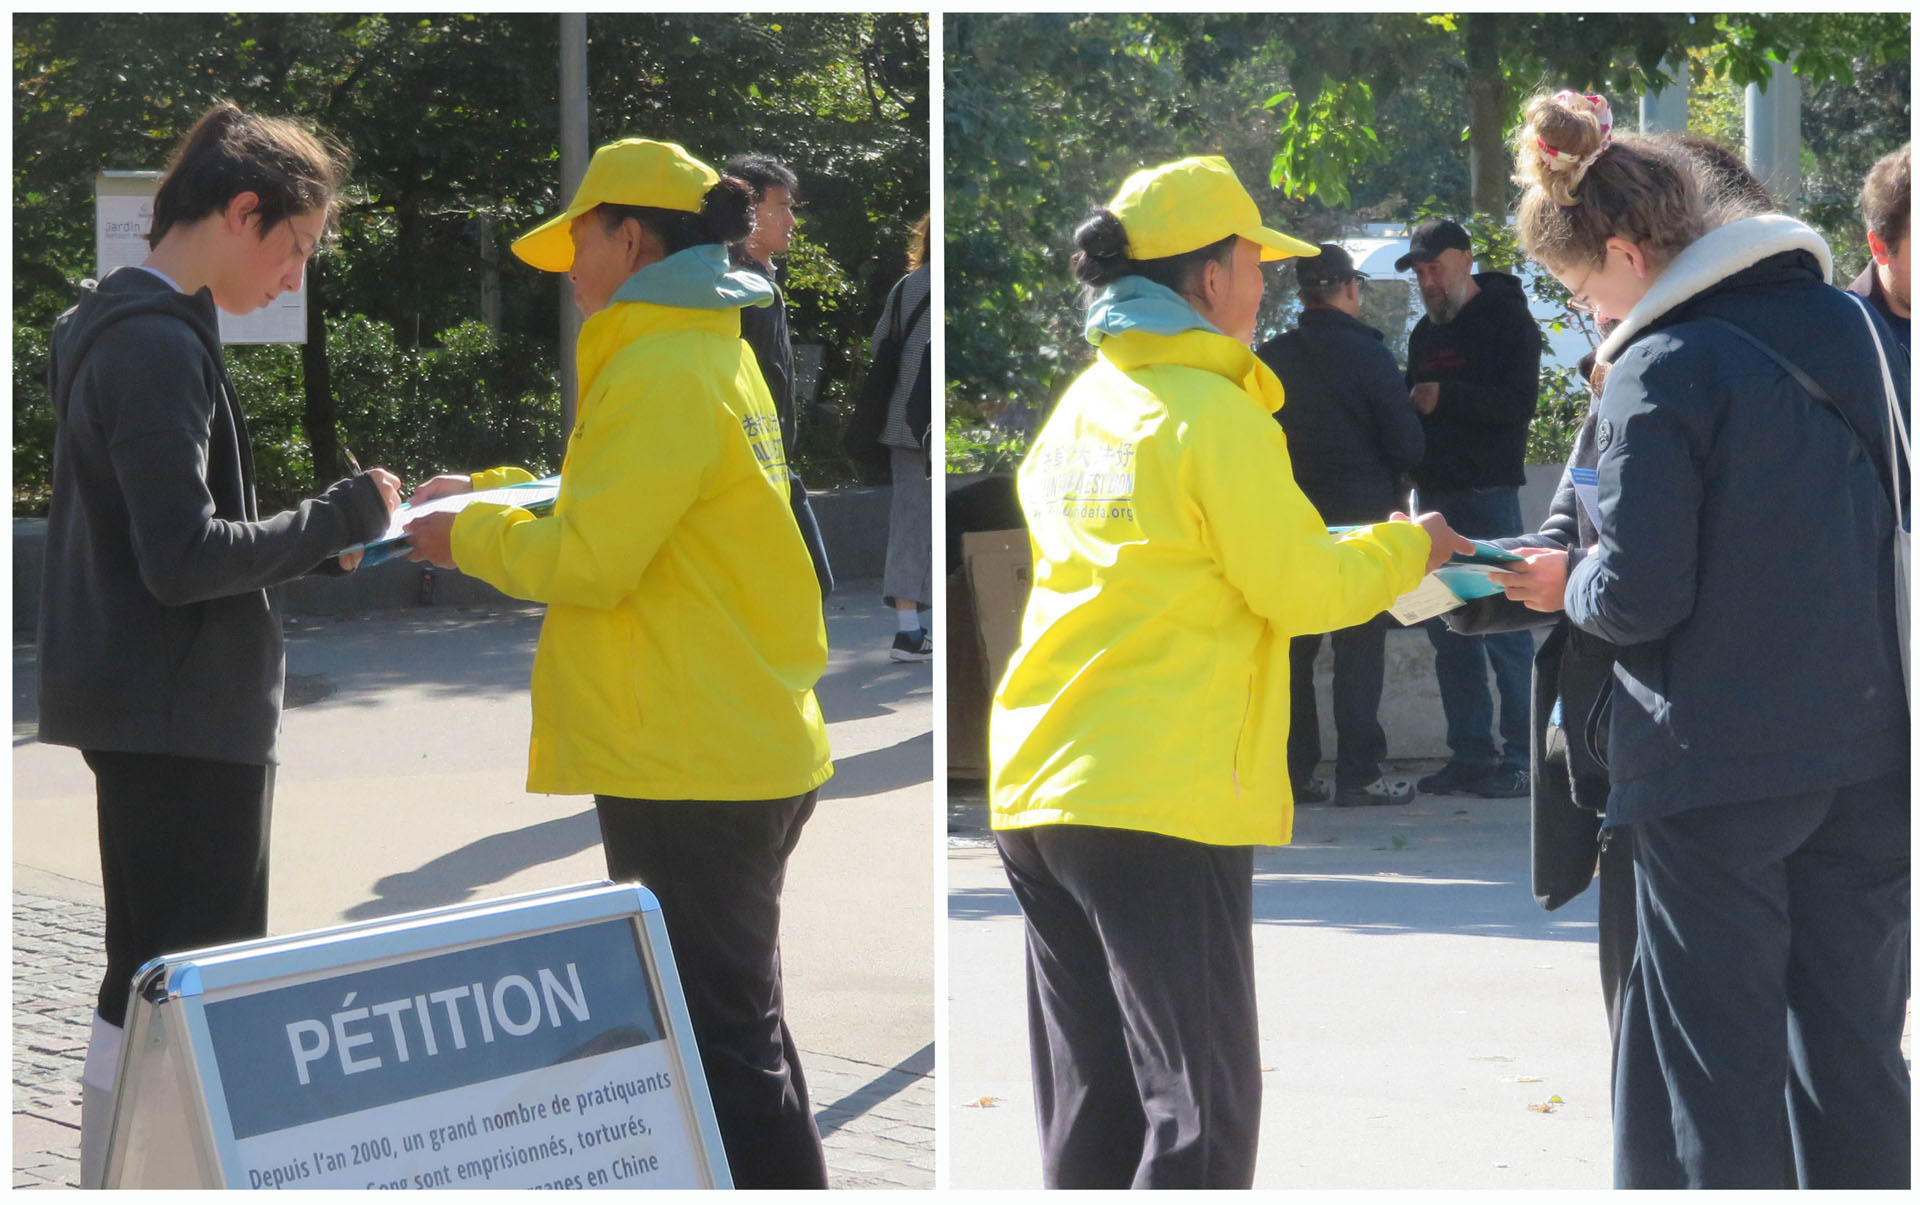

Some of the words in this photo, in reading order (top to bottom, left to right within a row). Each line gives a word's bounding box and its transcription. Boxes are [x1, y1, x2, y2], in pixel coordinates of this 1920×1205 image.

[105, 220, 140, 232] Jardin
[286, 962, 591, 1086] PÉTITION
[248, 1158, 310, 1190] Depuis
[350, 1137, 398, 1166] 2000,
[403, 1131, 425, 1153] un
[429, 1115, 477, 1152] grand
[482, 1103, 547, 1133] nombre
[551, 1094, 572, 1115] de
[576, 1071, 672, 1115] pratiquants
[414, 1164, 452, 1190] sont
[457, 1134, 574, 1180] emprisionnés,
[577, 1115, 652, 1150] torturés,
[587, 1168, 609, 1188] en
[612, 1153, 660, 1181] Chine
